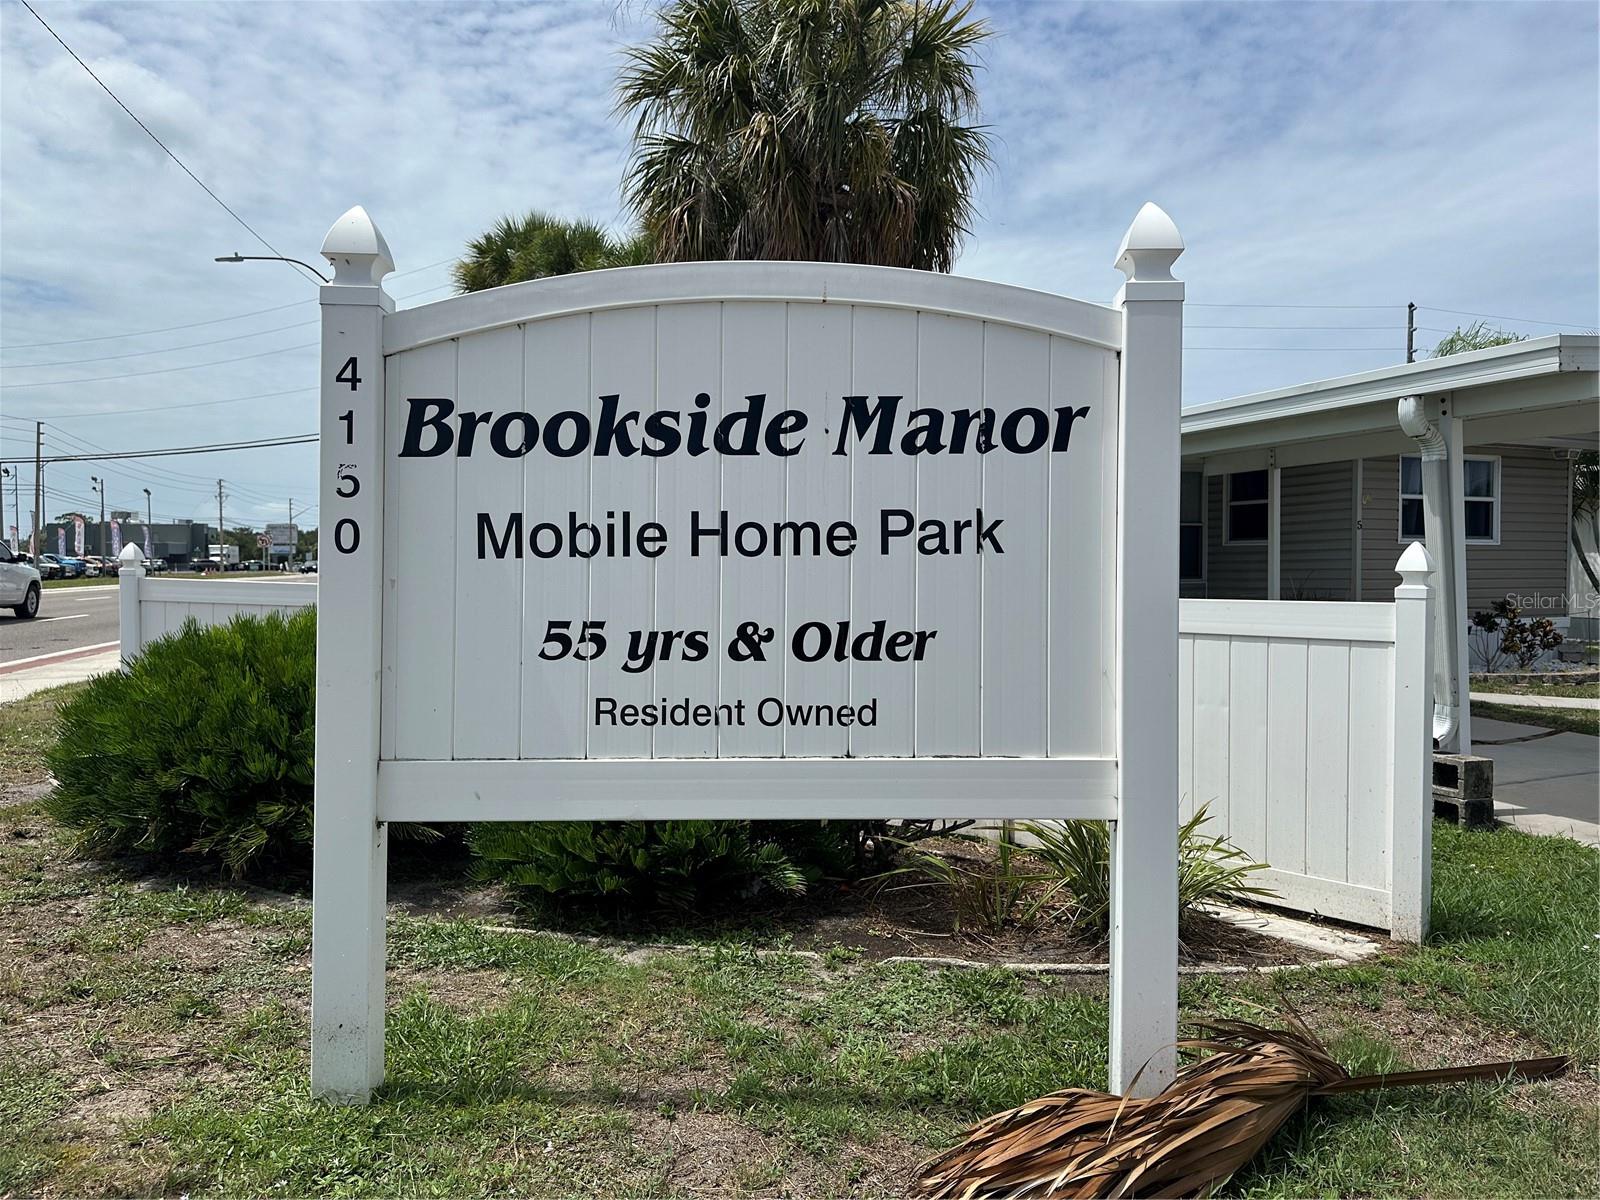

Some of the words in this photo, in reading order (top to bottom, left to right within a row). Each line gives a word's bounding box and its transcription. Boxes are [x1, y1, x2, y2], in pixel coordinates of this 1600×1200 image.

[397, 393, 809, 459] Brookside
[831, 394, 1091, 457] Manor
[476, 510, 668, 560] Mobile
[690, 510, 858, 558] Home
[880, 507, 1006, 556] Park
[537, 619, 607, 662] 55
[620, 629, 709, 674] yrs
[727, 620, 775, 662] &
[791, 619, 938, 663] Older
[594, 697, 746, 727] Resident
[757, 696, 877, 727] Owned
